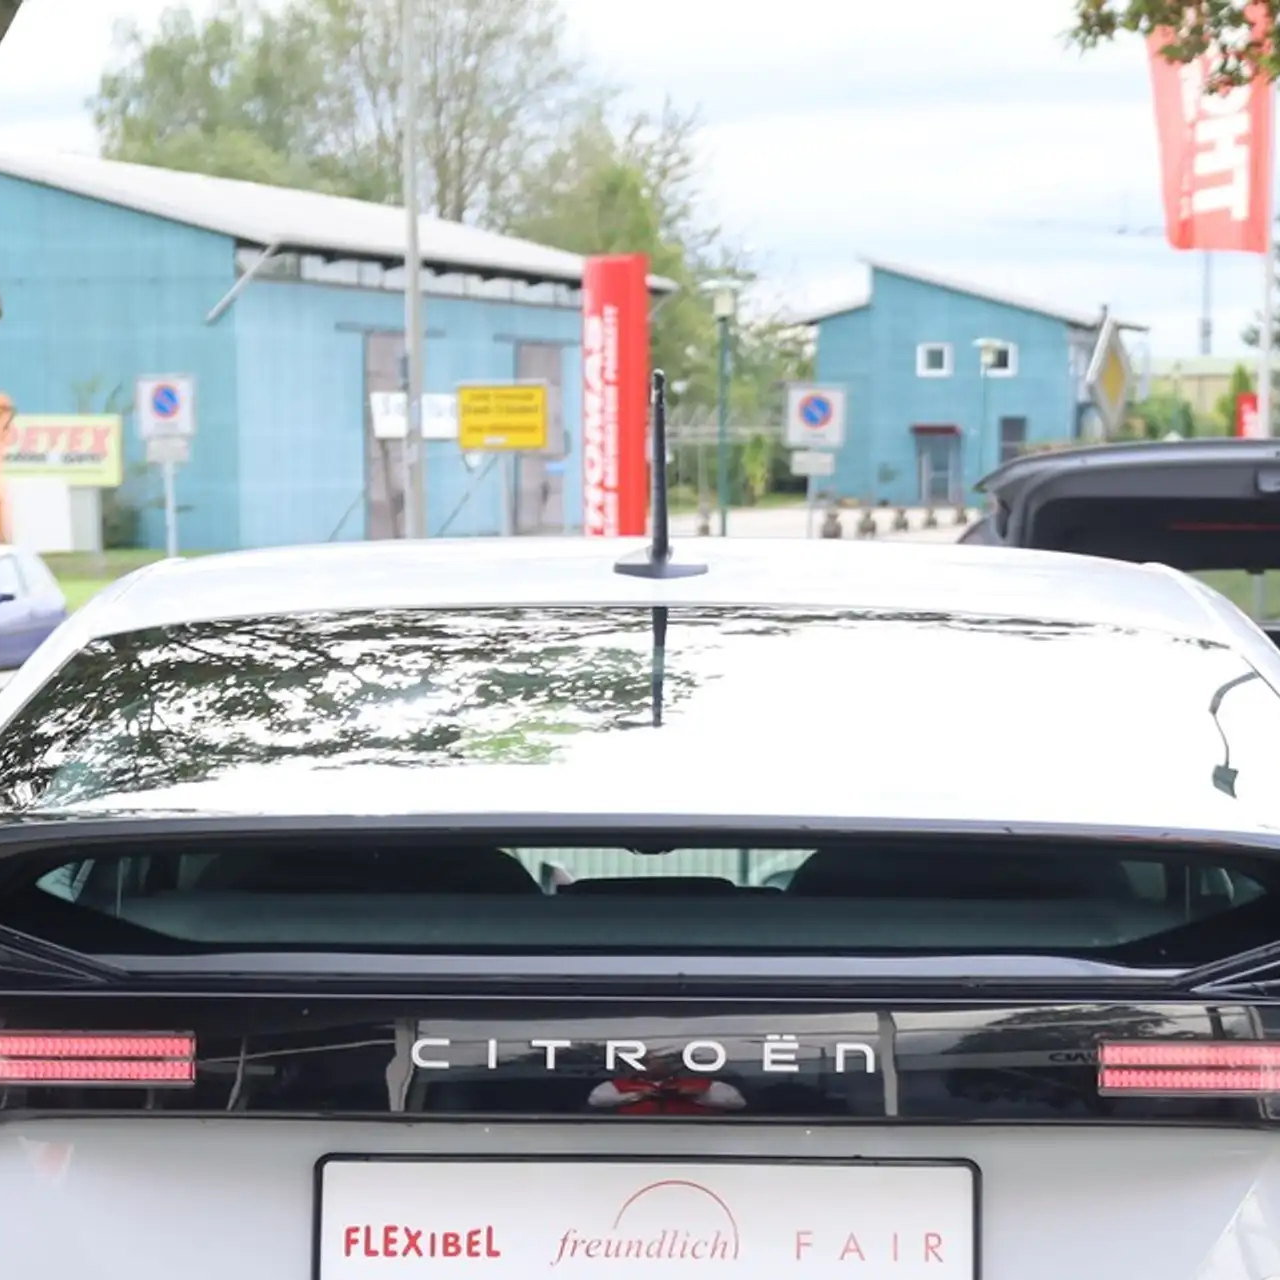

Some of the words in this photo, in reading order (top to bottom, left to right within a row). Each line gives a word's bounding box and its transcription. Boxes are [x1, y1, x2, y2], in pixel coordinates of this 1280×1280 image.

[344, 1225, 501, 1257] FLEXIBEL
[549, 1228, 728, 1268] freundlich
[795, 1230, 944, 1263] FAIR
